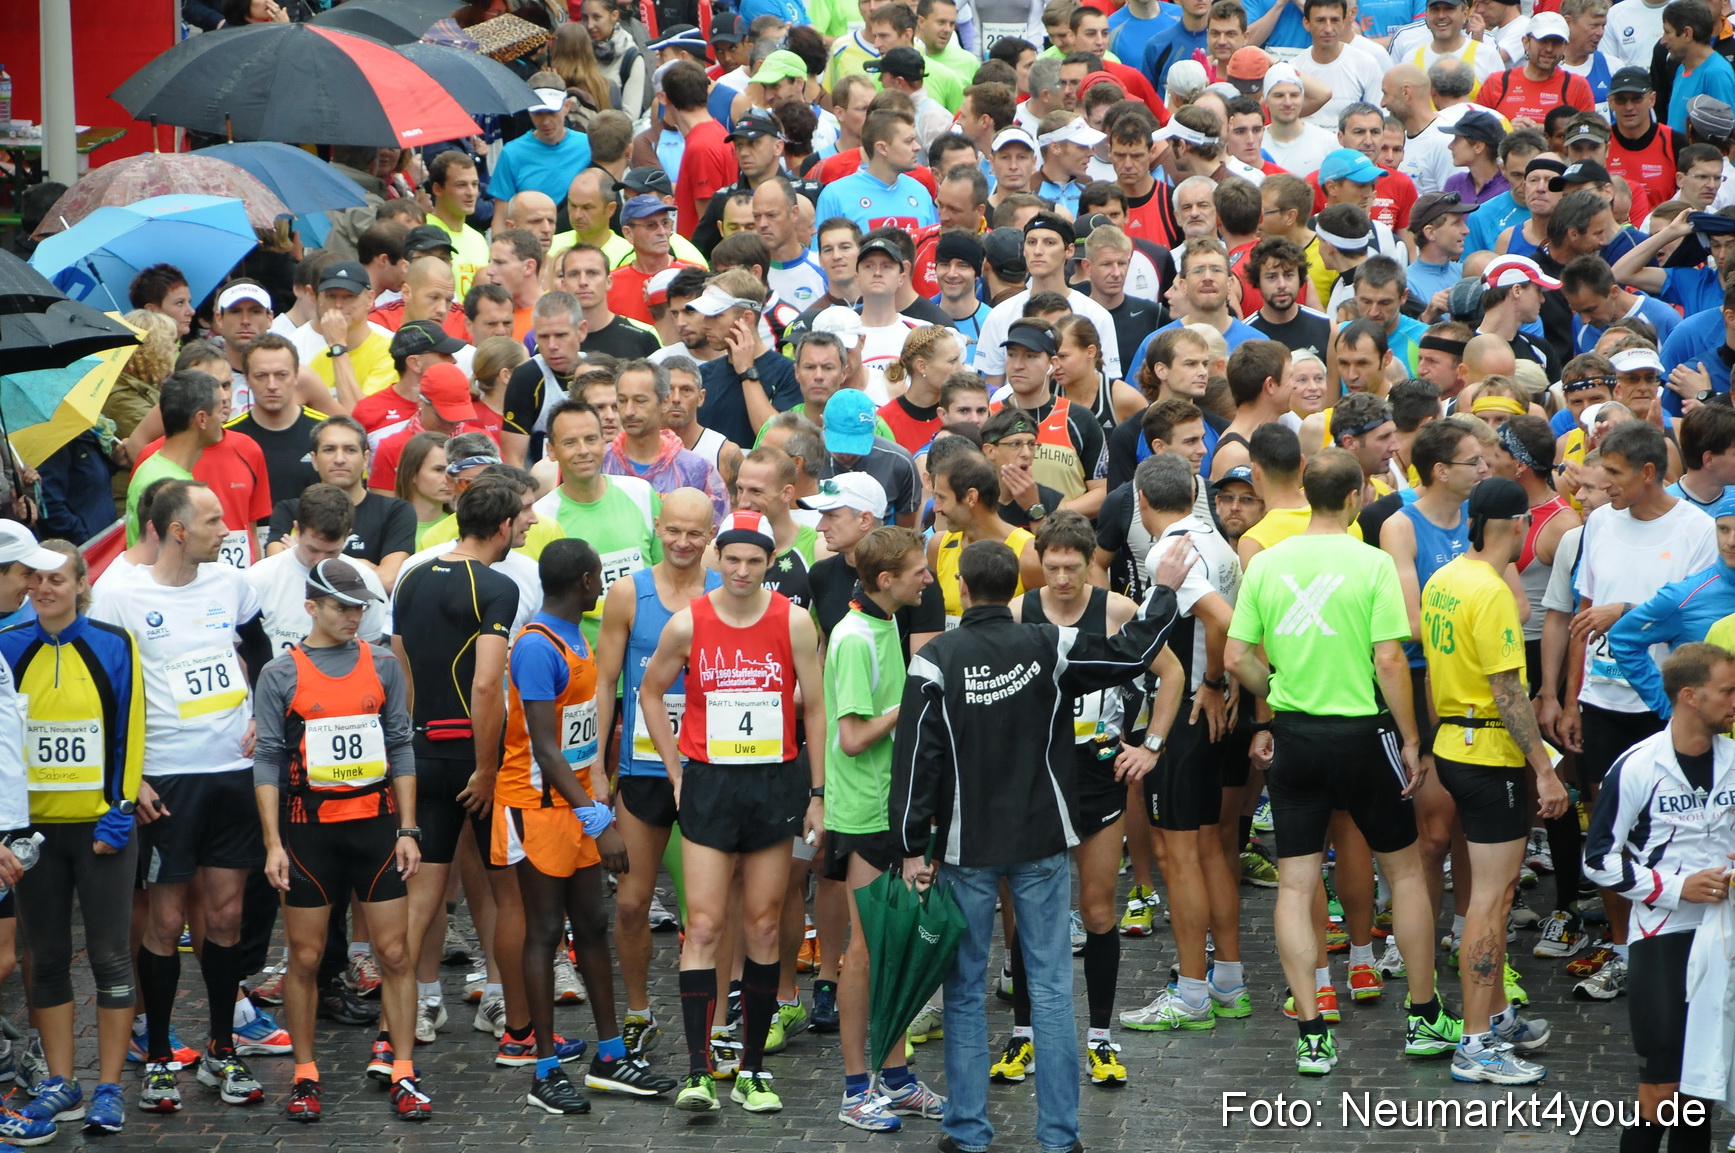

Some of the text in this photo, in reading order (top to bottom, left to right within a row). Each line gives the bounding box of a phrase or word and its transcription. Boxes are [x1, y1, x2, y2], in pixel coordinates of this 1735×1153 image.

[603, 557, 631, 567] eumarkt
[146, 628, 170, 636] PARTL
[275, 629, 301, 639] PARTL
[165, 653, 224, 671] PARTL Neumarkt
[185, 663, 230, 695] 578
[703, 667, 767, 681] TSV 1860 Staffelstein
[964, 665, 991, 679] LLC
[965, 663, 1025, 691] Marathon
[717, 679, 757, 687] Leichtathletik
[966, 660, 1041, 705] Regensburg
[307, 721, 368, 732] PARTL Neumarkt
[738, 711, 753, 735] 4
[38, 737, 85, 763] 586
[332, 733, 363, 760] 98
[734, 744, 756, 754] Uwe
[37, 767, 80, 780] Sabine
[333, 766, 363, 780] Hynek
